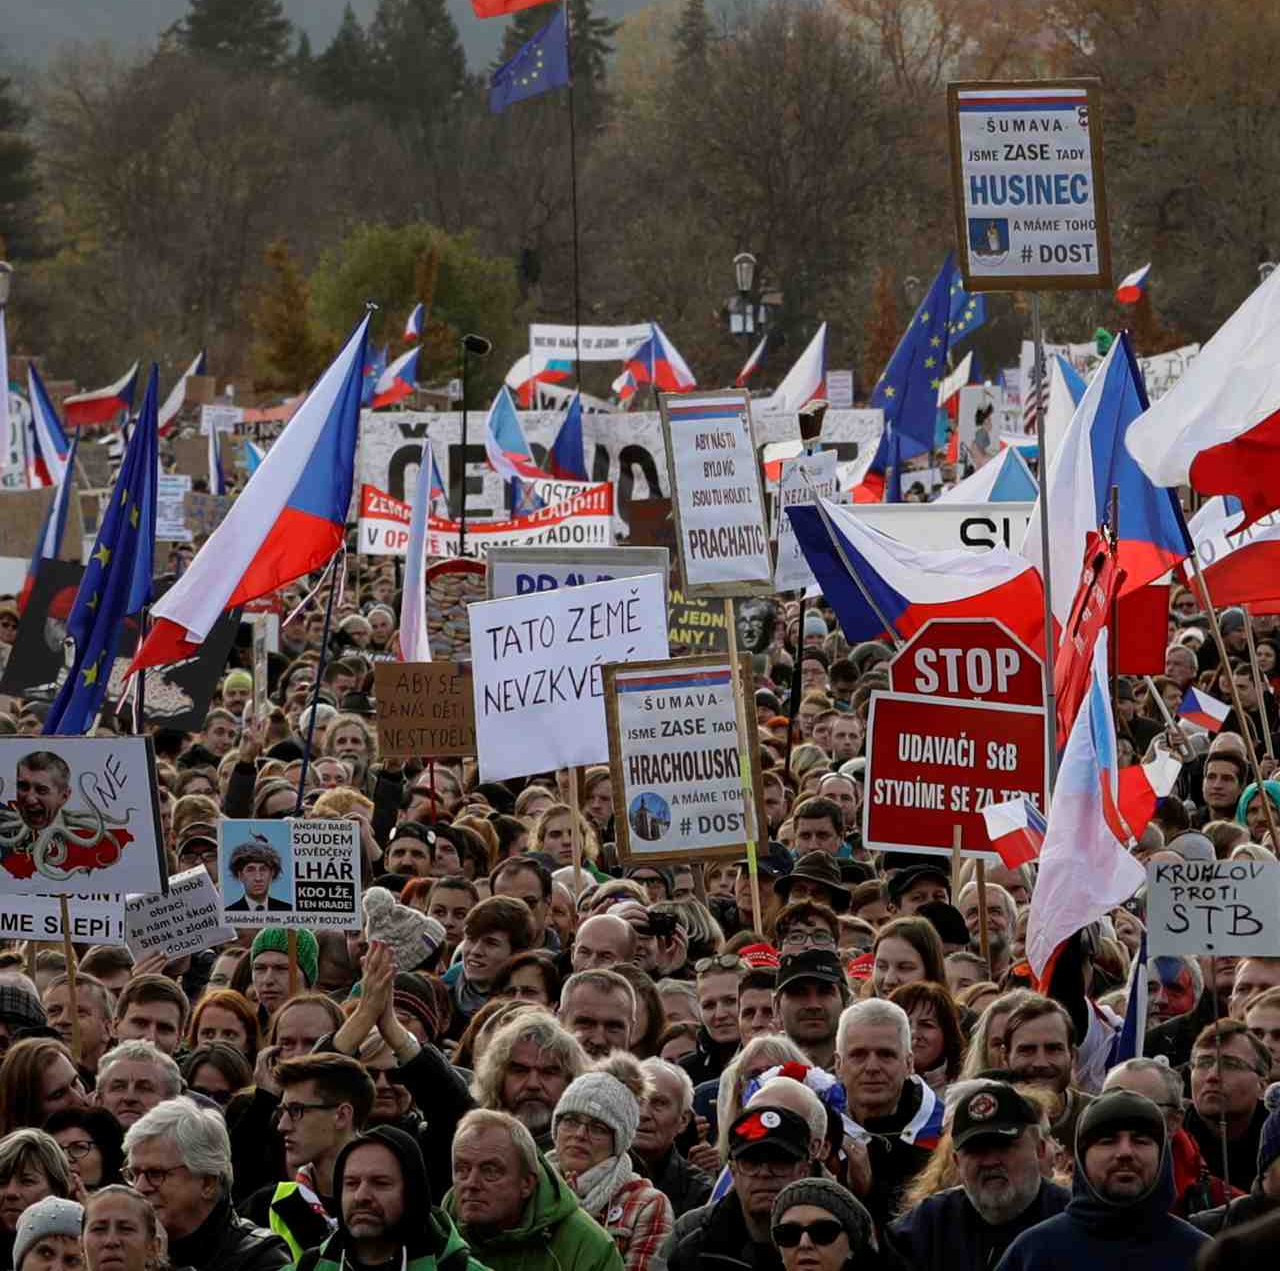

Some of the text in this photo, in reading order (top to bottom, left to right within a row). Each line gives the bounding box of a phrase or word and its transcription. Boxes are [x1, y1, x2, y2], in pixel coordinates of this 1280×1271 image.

[968, 144, 1085, 162] JSME ZASE TADY
[971, 173, 1089, 205] HUSINEC
[1014, 218, 1097, 231] A MÁME TOHO
[1040, 244, 1093, 263] DOST
[696, 433, 709, 451] ABY
[726, 432, 736, 449] TU
[704, 460, 722, 478] BYLO
[692, 489, 711, 507] JSOU
[712, 489, 723, 505] TU
[367, 527, 378, 546] V
[688, 524, 765, 560] PRACHATIC
[485, 587, 642, 660] TATO ZEMĚ
[914, 647, 1020, 694] STOP
[439, 673, 461, 695] SE
[628, 728, 657, 740] JSME
[661, 718, 706, 737] ZASE
[898, 732, 1018, 771] UDAVAČI StB
[96, 754, 128, 809] NE
[681, 790, 718, 805] MÁME
[723, 789, 752, 802] TOH
[874, 776, 945, 810] STYDÍME
[950, 785, 970, 812] SE
[975, 787, 995, 814] ZA
[293, 833, 353, 845] SOUDEM
[295, 858, 353, 880] LHÁŘ
[1156, 862, 1264, 883] KRUMLOV
[298, 887, 326, 898] KDO
[1170, 886, 1237, 901] PROTI
[299, 900, 353, 910] TEN KRADE!
[118, 921, 124, 938] !
